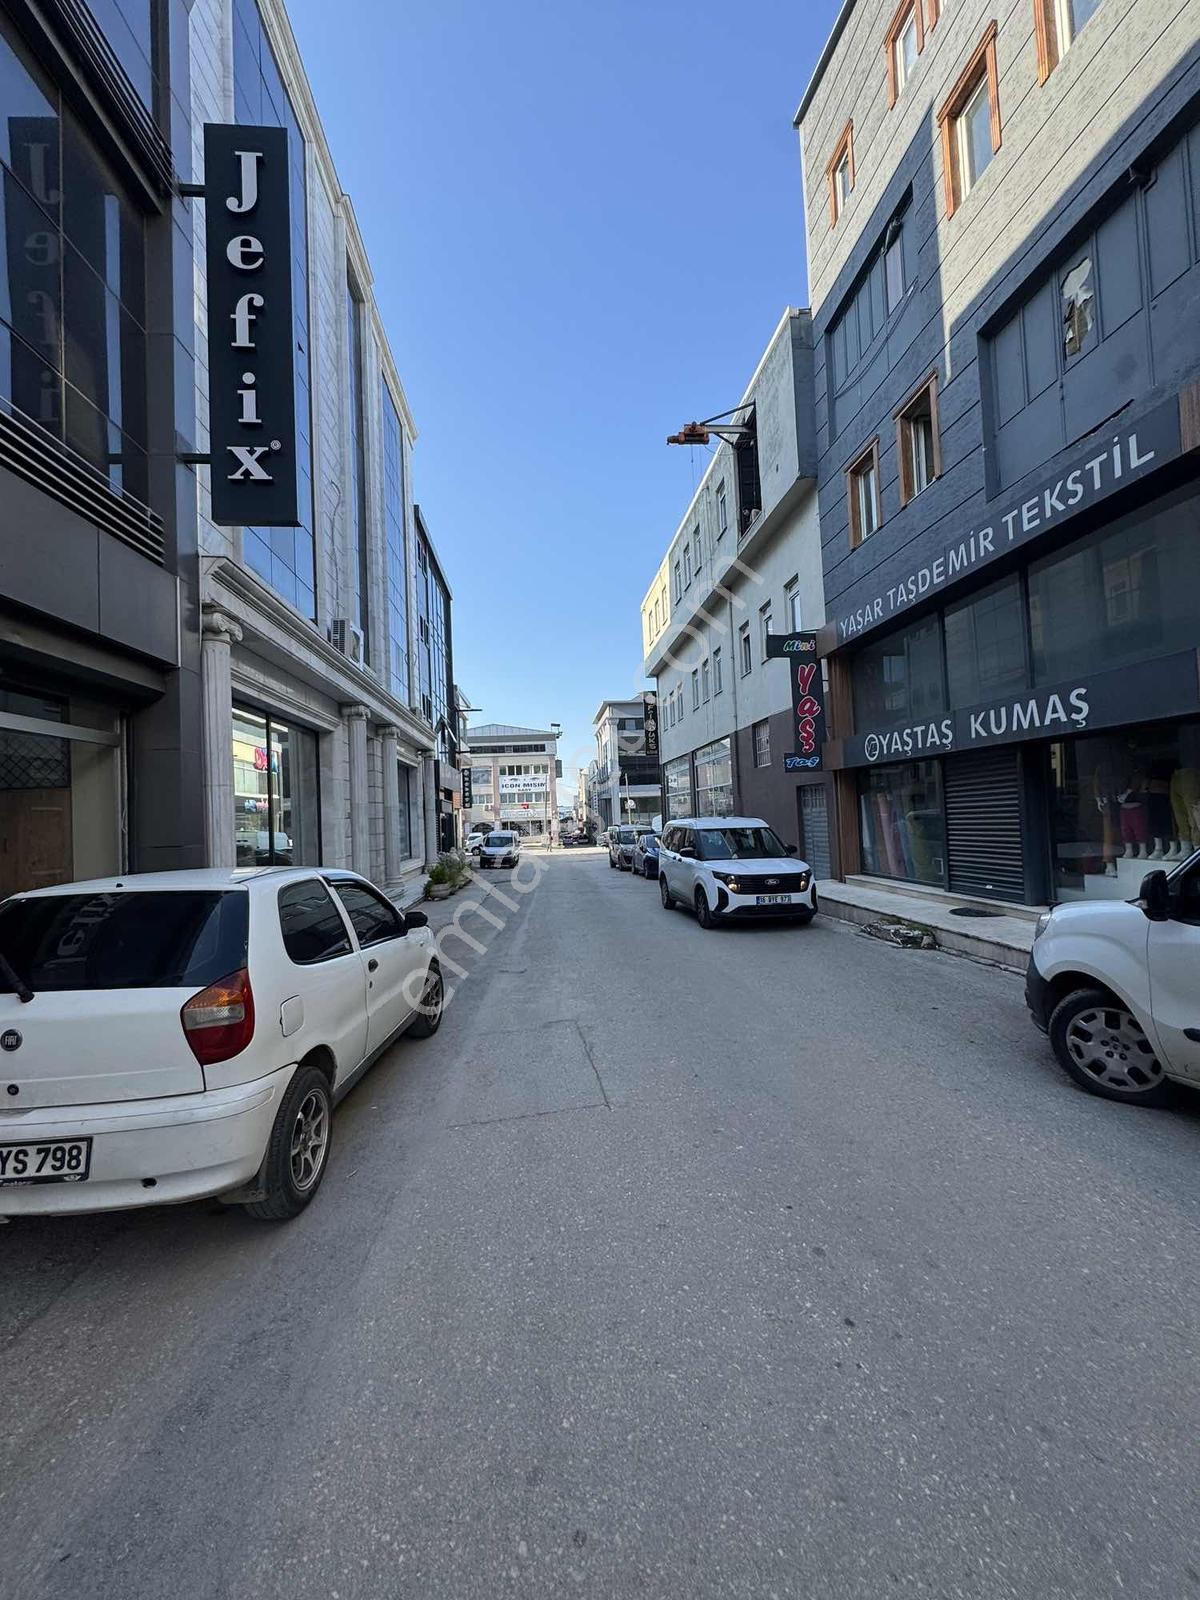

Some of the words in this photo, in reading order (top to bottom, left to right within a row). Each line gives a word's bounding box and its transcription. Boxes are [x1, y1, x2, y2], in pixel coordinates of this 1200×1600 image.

[226, 151, 274, 481] Jefix
[839, 598, 884, 640] YAŞAR
[886, 526, 996, 611] TAŞDEMİR
[1001, 433, 1156, 542] TEKSTİL
[783, 639, 816, 652] Mini
[878, 718, 954, 757] YAŞTAŞ
[969, 687, 1090, 739] KUMAŞ
[35, 1144, 82, 1173] 798
